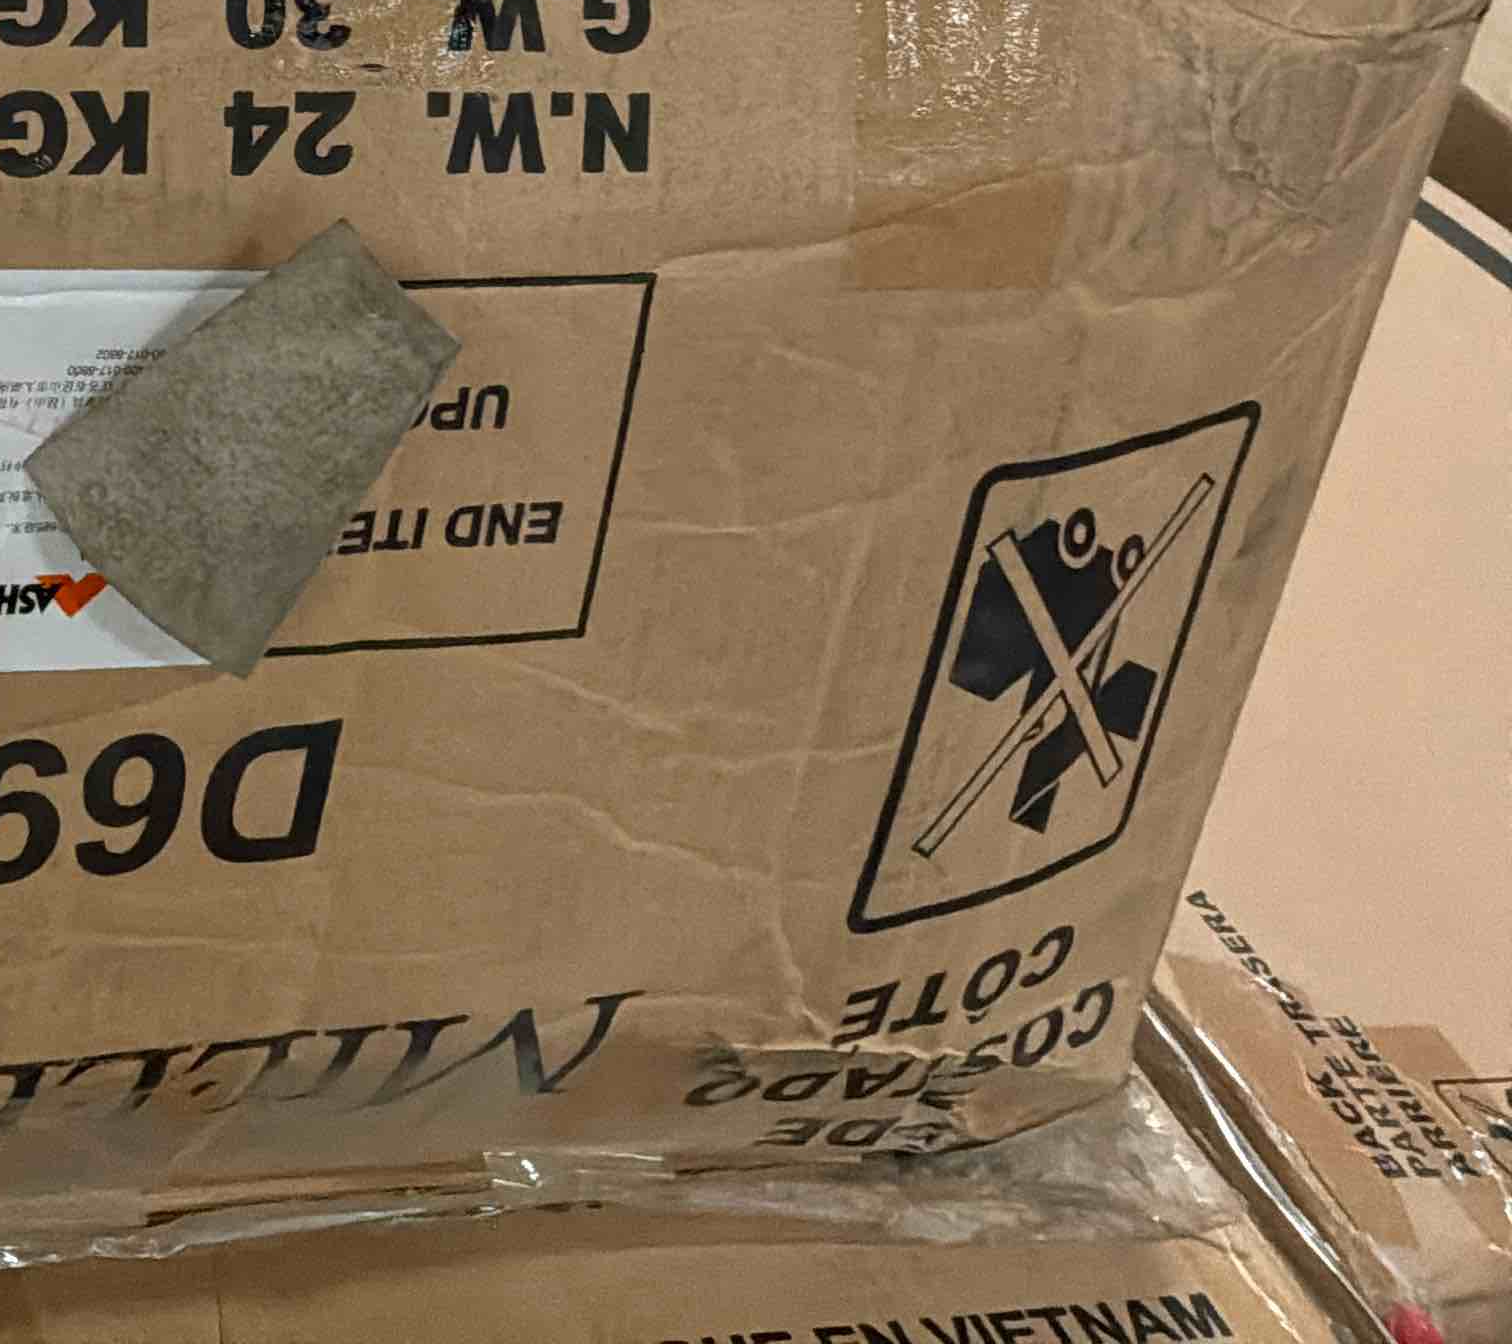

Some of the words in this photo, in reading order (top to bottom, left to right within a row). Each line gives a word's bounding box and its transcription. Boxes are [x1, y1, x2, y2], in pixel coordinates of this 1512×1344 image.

[223, 91, 358, 177] 24
[426, 91, 652, 175] N.W.
[326, 506, 429, 556] ITE
[444, 500, 564, 549] END
